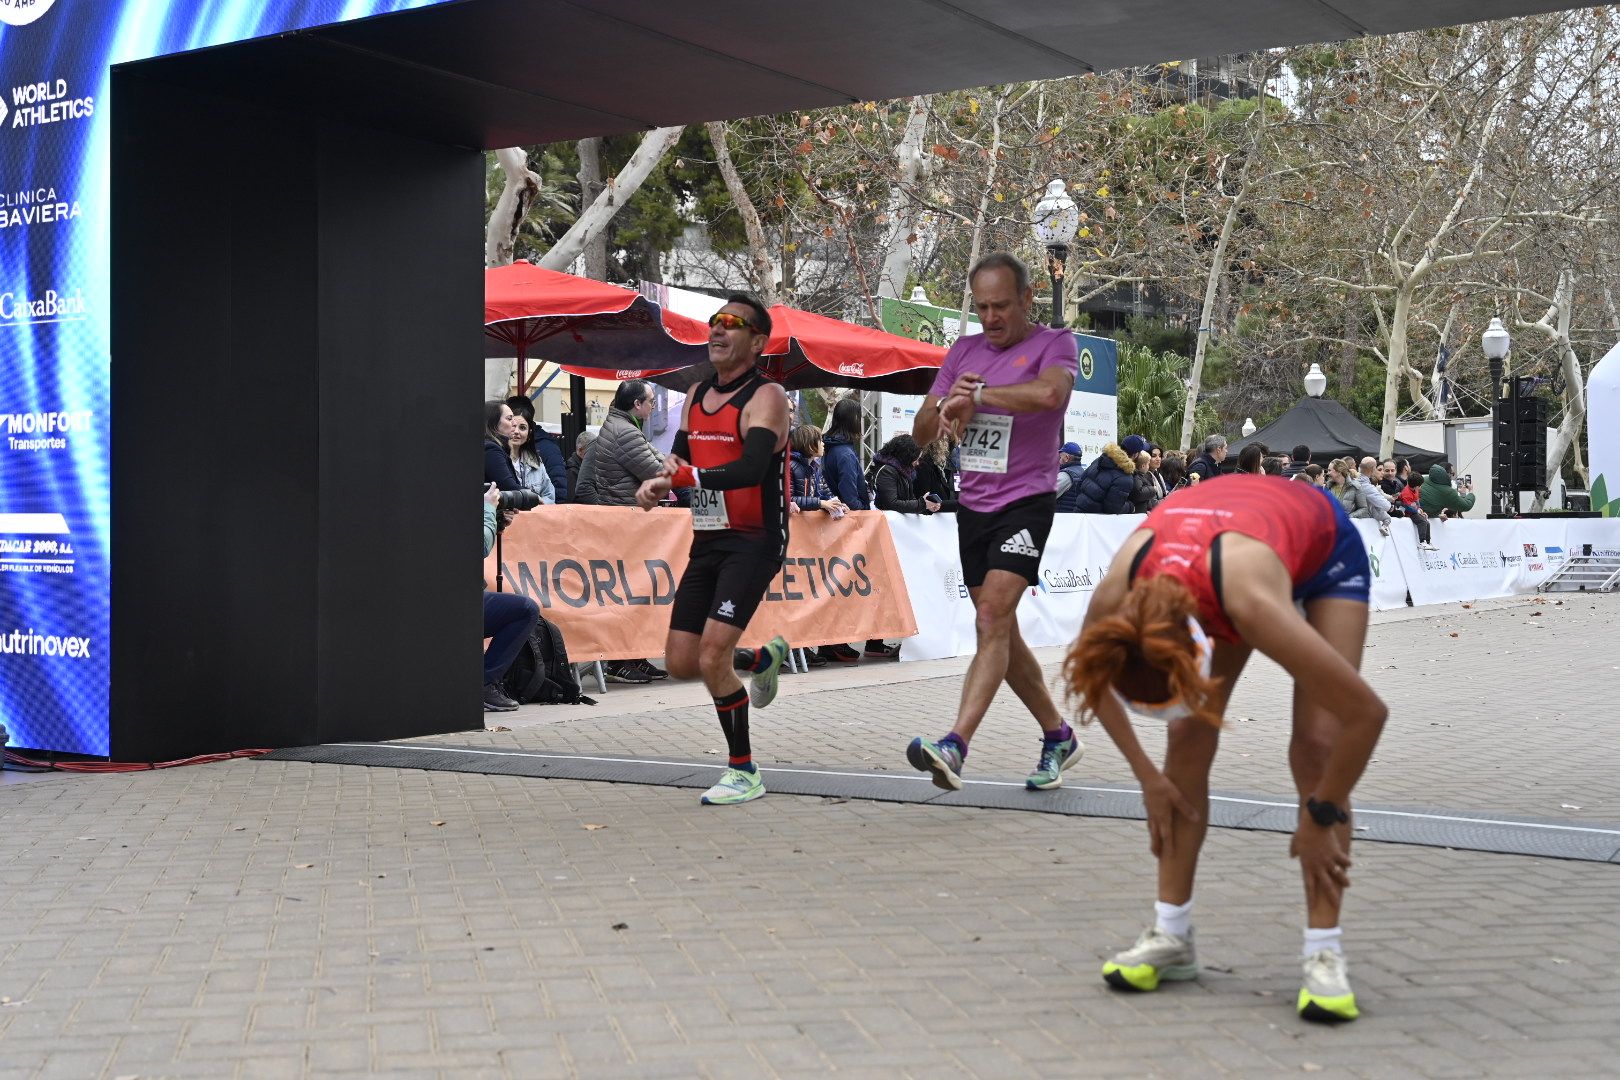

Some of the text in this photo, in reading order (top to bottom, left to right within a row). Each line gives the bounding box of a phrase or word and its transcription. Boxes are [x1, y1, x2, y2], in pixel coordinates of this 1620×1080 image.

[12, 79, 67, 106] WORLD
[12, 96, 94, 129] ATHLETICS
[0, 188, 57, 207] CLINICA
[0, 201, 83, 229] BAVIERA
[0, 288, 86, 319] CaixaBank
[8, 411, 93, 434] MONFORT
[8, 436, 66, 452] Transportes
[692, 489, 718, 508] 504
[1000, 543, 1039, 558] adidas
[501, 558, 676, 608] WORLD
[766, 554, 871, 601] LETICS
[1044, 567, 1093, 588] CaixaBank
[0, 627, 90, 658] utrinovex
